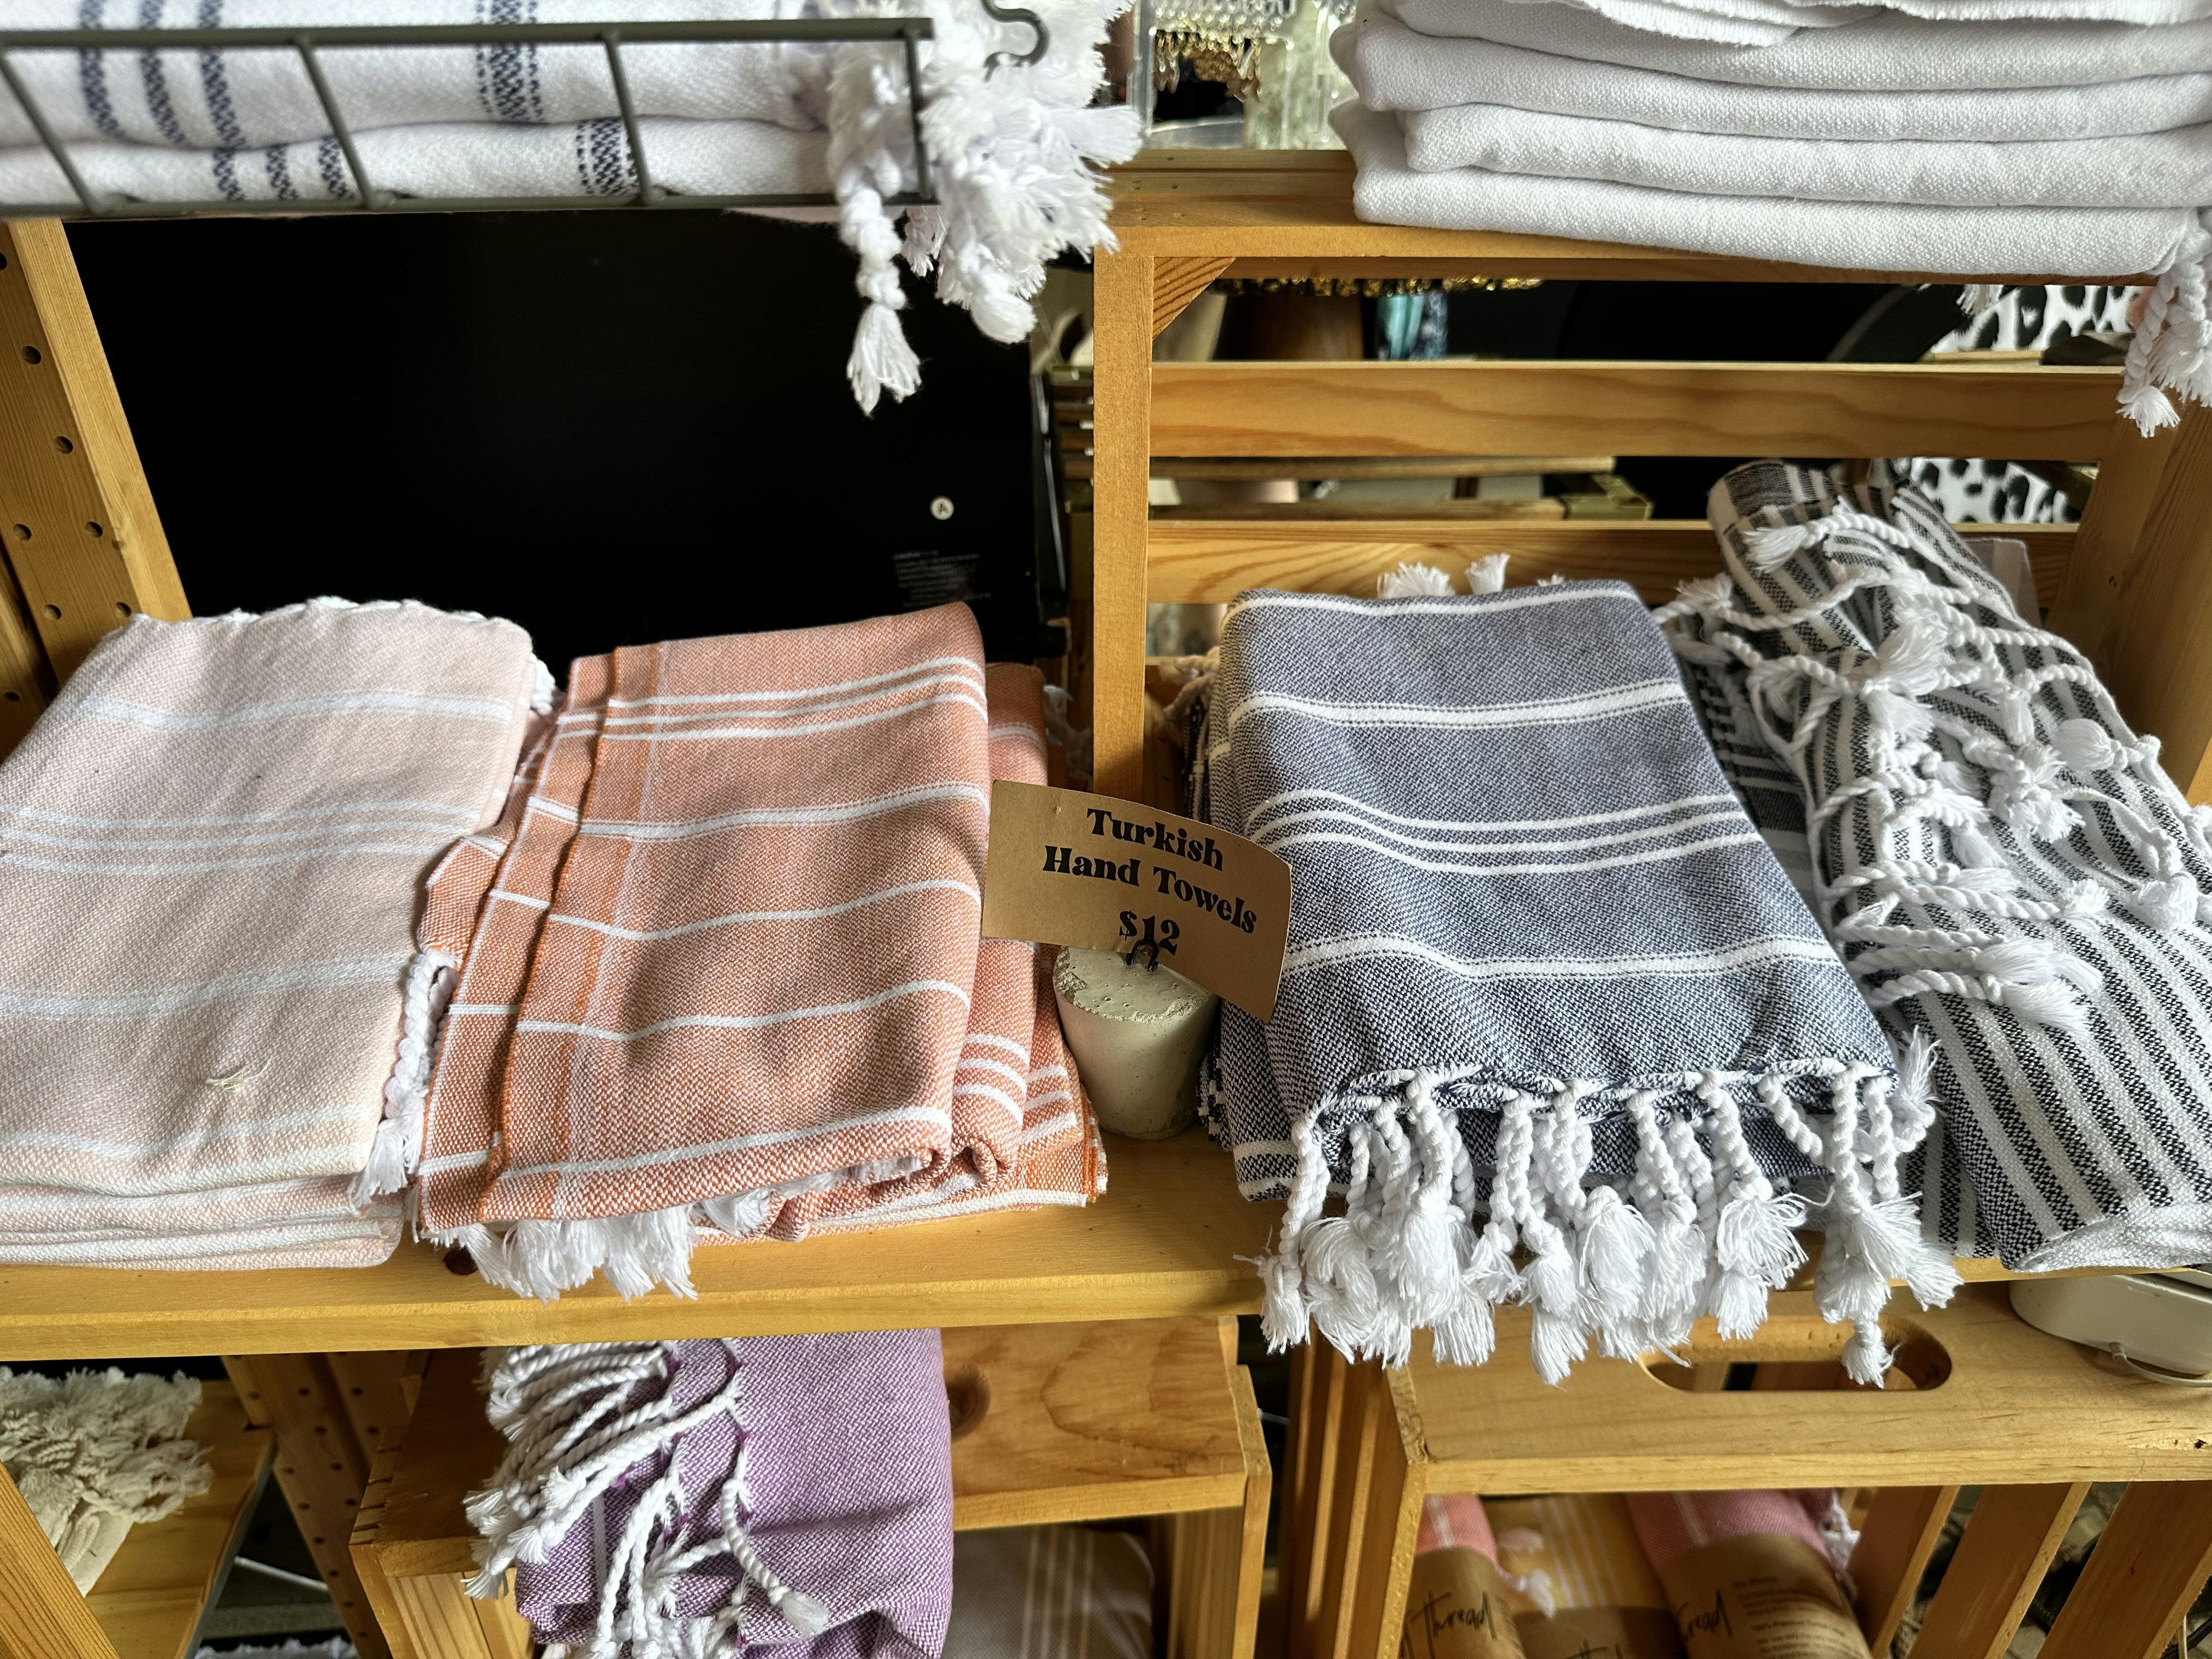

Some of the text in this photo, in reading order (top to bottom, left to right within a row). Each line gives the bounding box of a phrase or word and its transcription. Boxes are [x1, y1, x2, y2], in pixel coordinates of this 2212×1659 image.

[1087, 808, 1223, 871] Turkish
[1043, 845, 1257, 934] Hand Towels
[1119, 910, 1181, 955] $12
